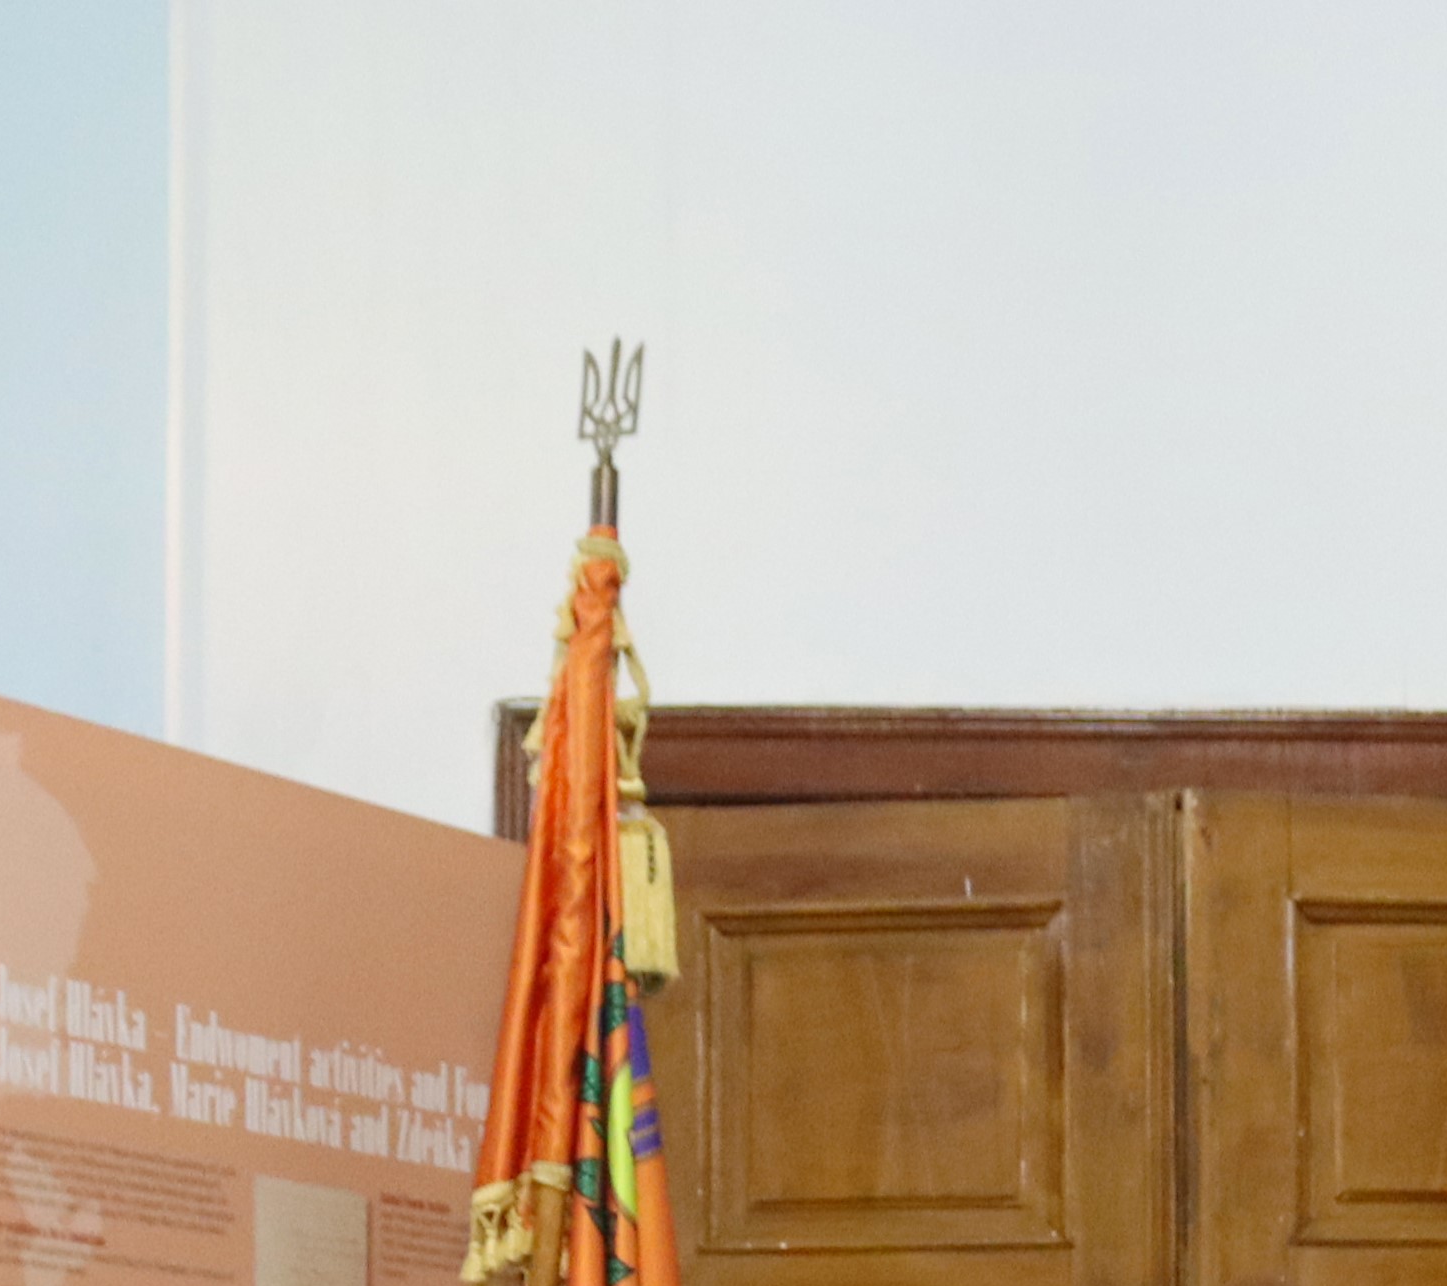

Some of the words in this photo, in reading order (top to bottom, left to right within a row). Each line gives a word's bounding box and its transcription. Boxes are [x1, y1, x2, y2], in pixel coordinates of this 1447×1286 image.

[171, 1060, 237, 1127] Marie
[350, 1103, 388, 1158] and
[411, 1060, 449, 1114] and
